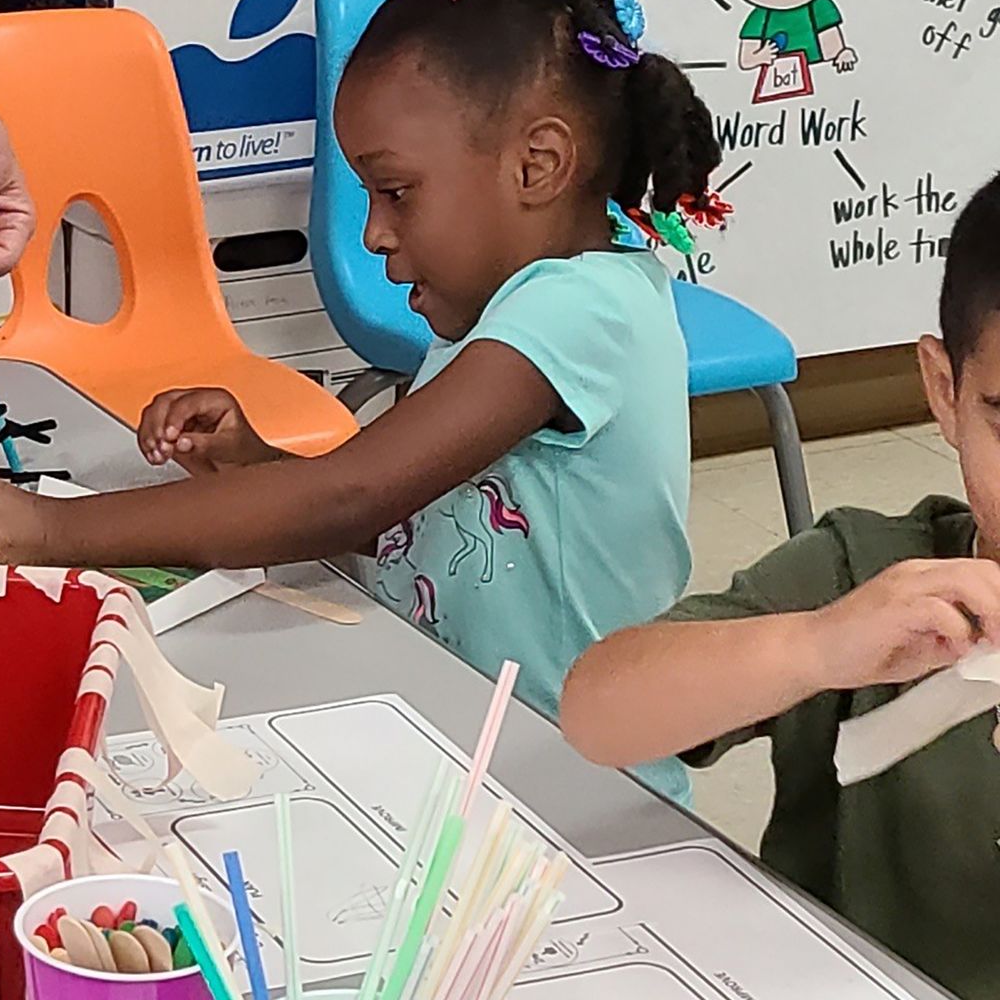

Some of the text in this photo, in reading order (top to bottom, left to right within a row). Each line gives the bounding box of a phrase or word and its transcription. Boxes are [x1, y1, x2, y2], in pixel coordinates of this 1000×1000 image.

[921, 19, 973, 61] off
[773, 63, 799, 88] bat
[716, 98, 868, 151] Word Work
[215, 140, 237, 161] to
[832, 171, 959, 226] work the
[829, 226, 901, 270] whole
